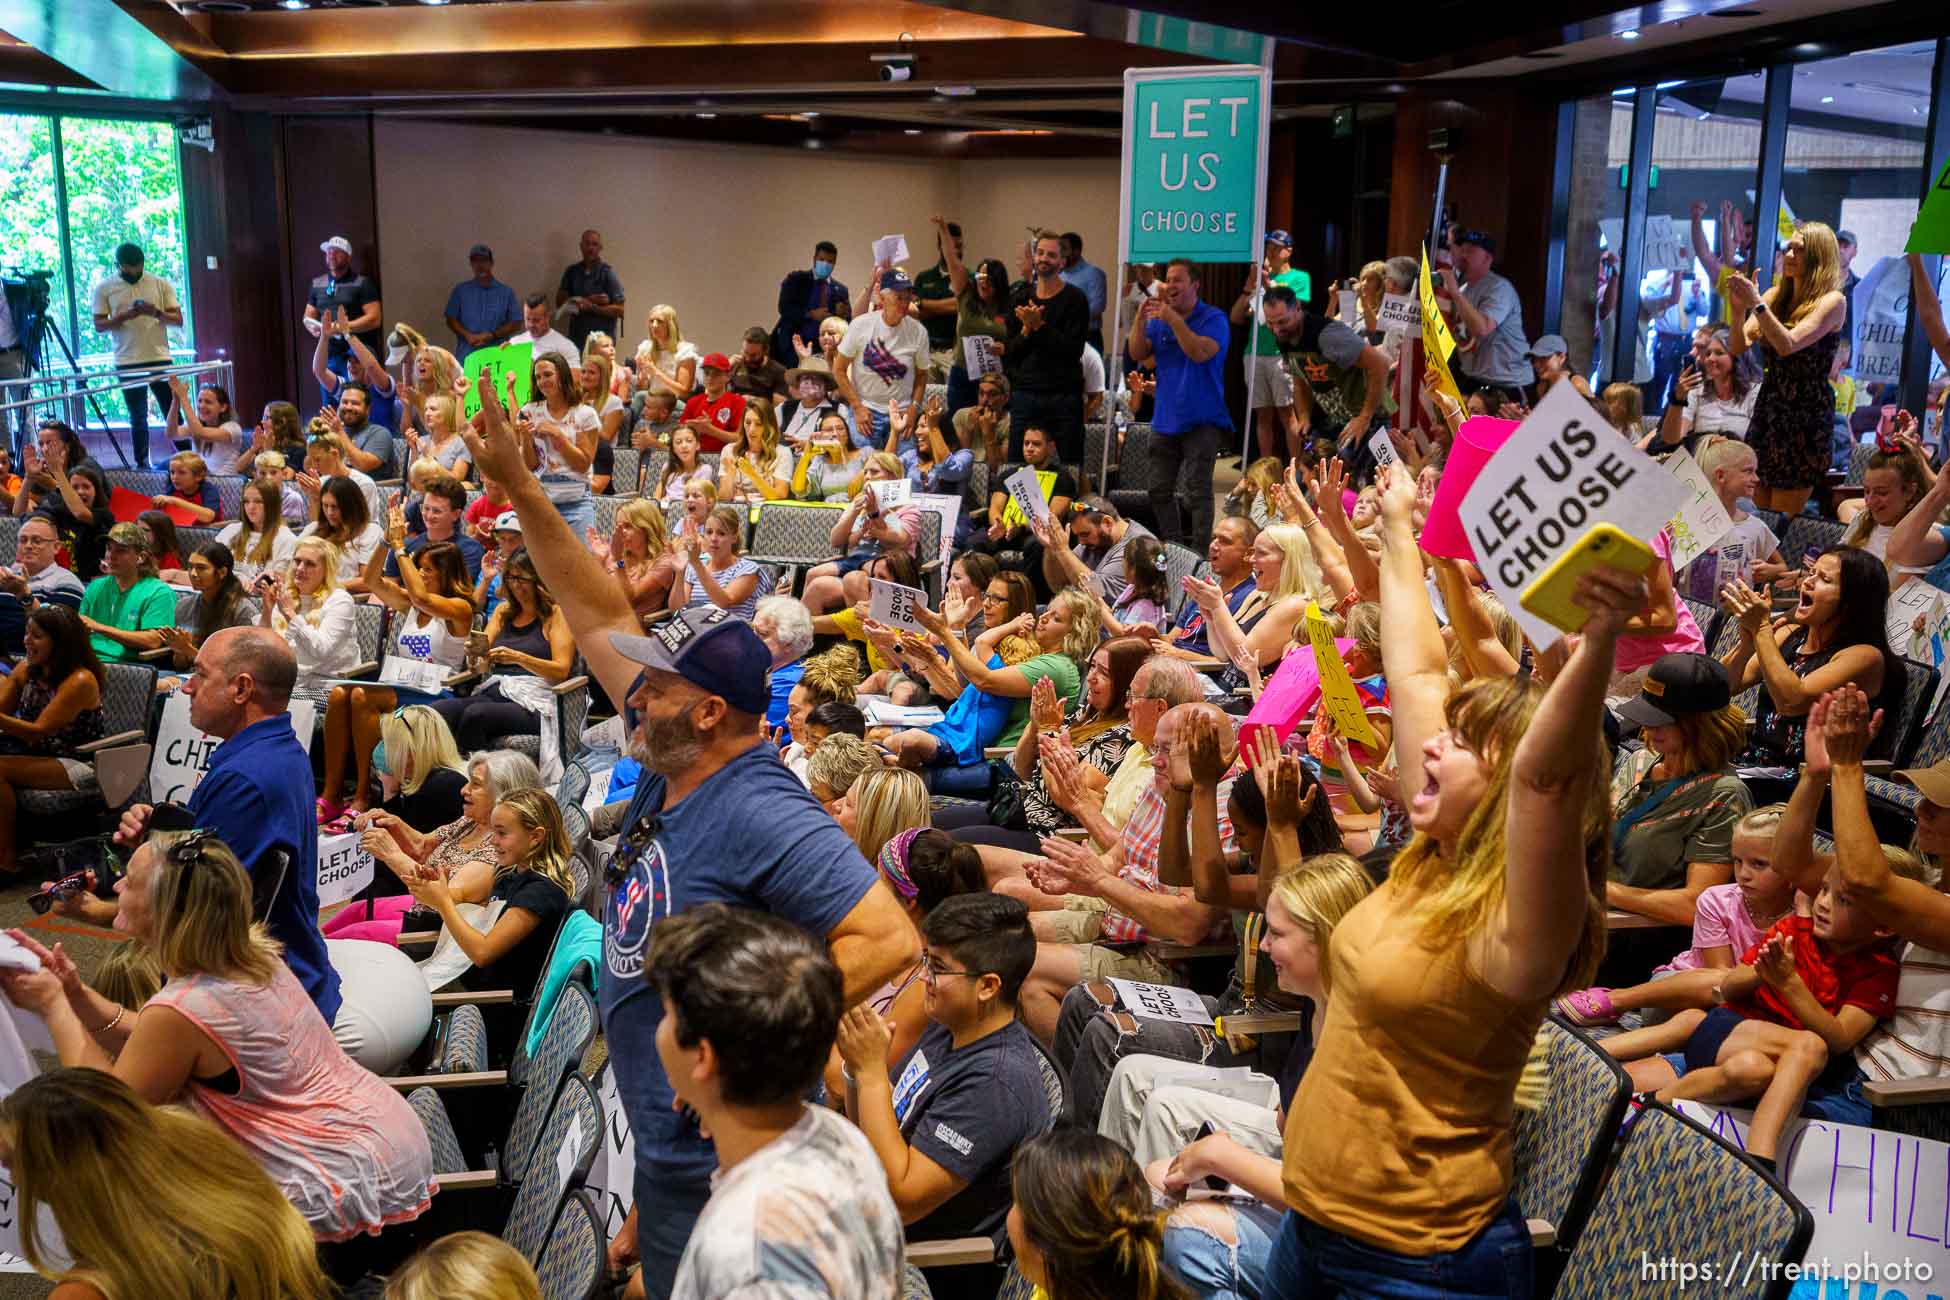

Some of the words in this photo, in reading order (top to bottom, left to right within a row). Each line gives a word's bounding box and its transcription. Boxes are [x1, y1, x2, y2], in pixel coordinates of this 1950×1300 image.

[1150, 97, 1248, 138] LET
[1160, 152, 1220, 191] US
[1141, 210, 1237, 233] CHOOSE
[1856, 322, 1904, 344] CHIL
[1475, 475, 1537, 558] LET
[1536, 419, 1597, 483] US
[1498, 452, 1636, 589] CHOOSE
[889, 587, 903, 620] OOSE
[318, 853, 372, 886] CHOOSE
[320, 847, 352, 872] LET
[1786, 1123, 1950, 1250] CHIL
